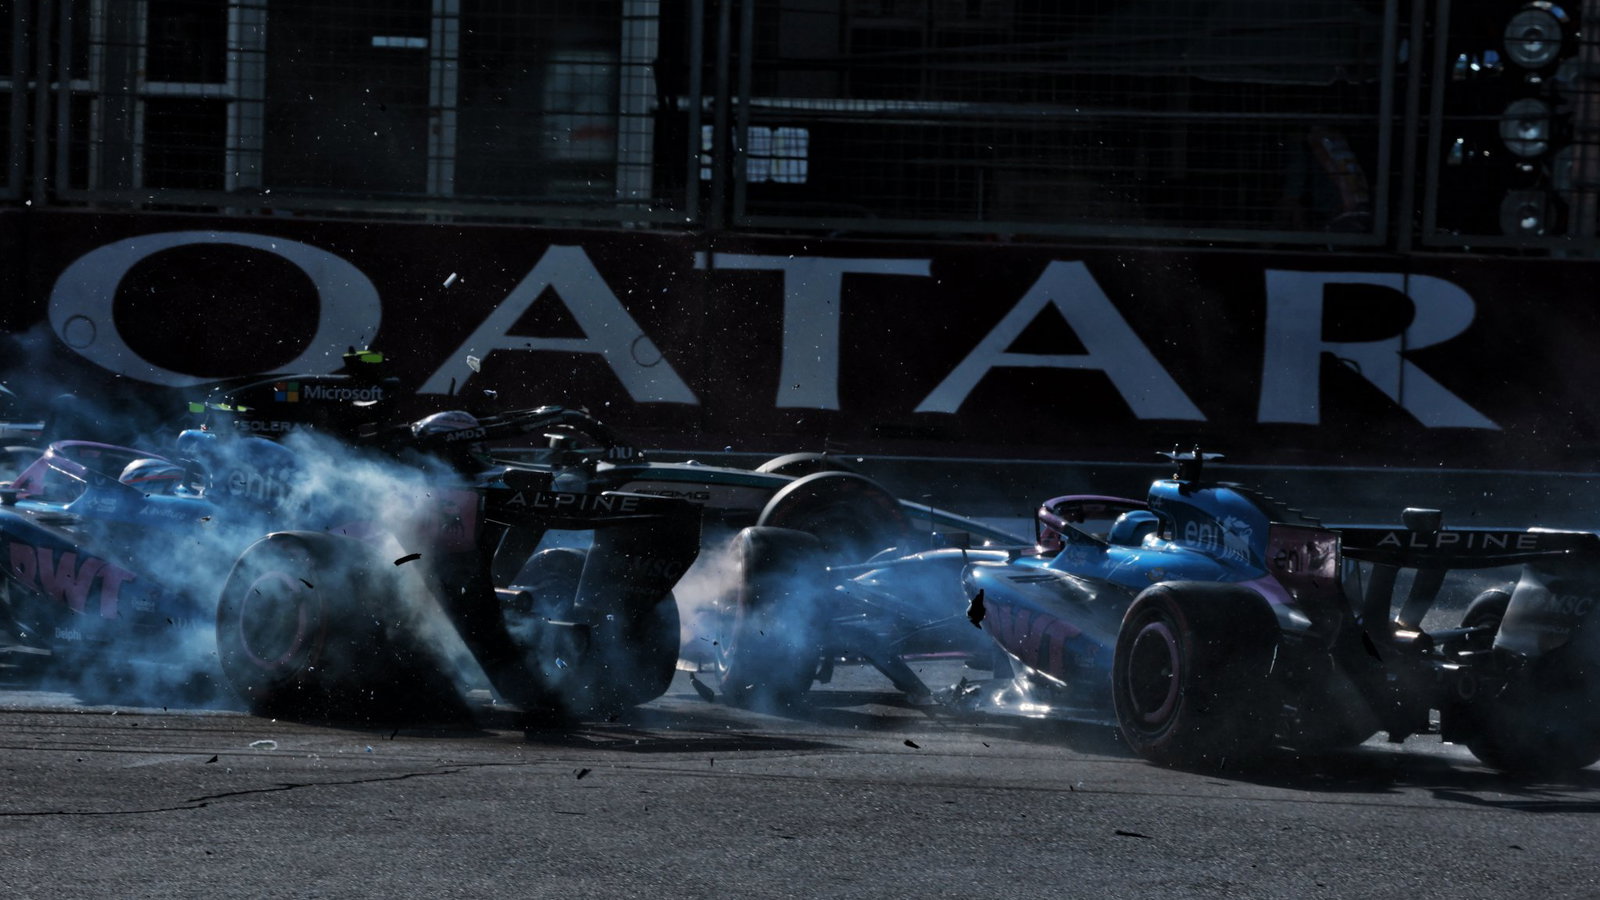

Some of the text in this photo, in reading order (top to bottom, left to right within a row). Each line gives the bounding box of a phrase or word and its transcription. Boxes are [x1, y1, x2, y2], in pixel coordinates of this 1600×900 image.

[48, 230, 1501, 430] QATAR
[303, 384, 383, 400] Microsoft
[506, 490, 641, 514] ALPINE
[1184, 516, 1220, 551] eni
[1376, 531, 1539, 550] ALPINE
